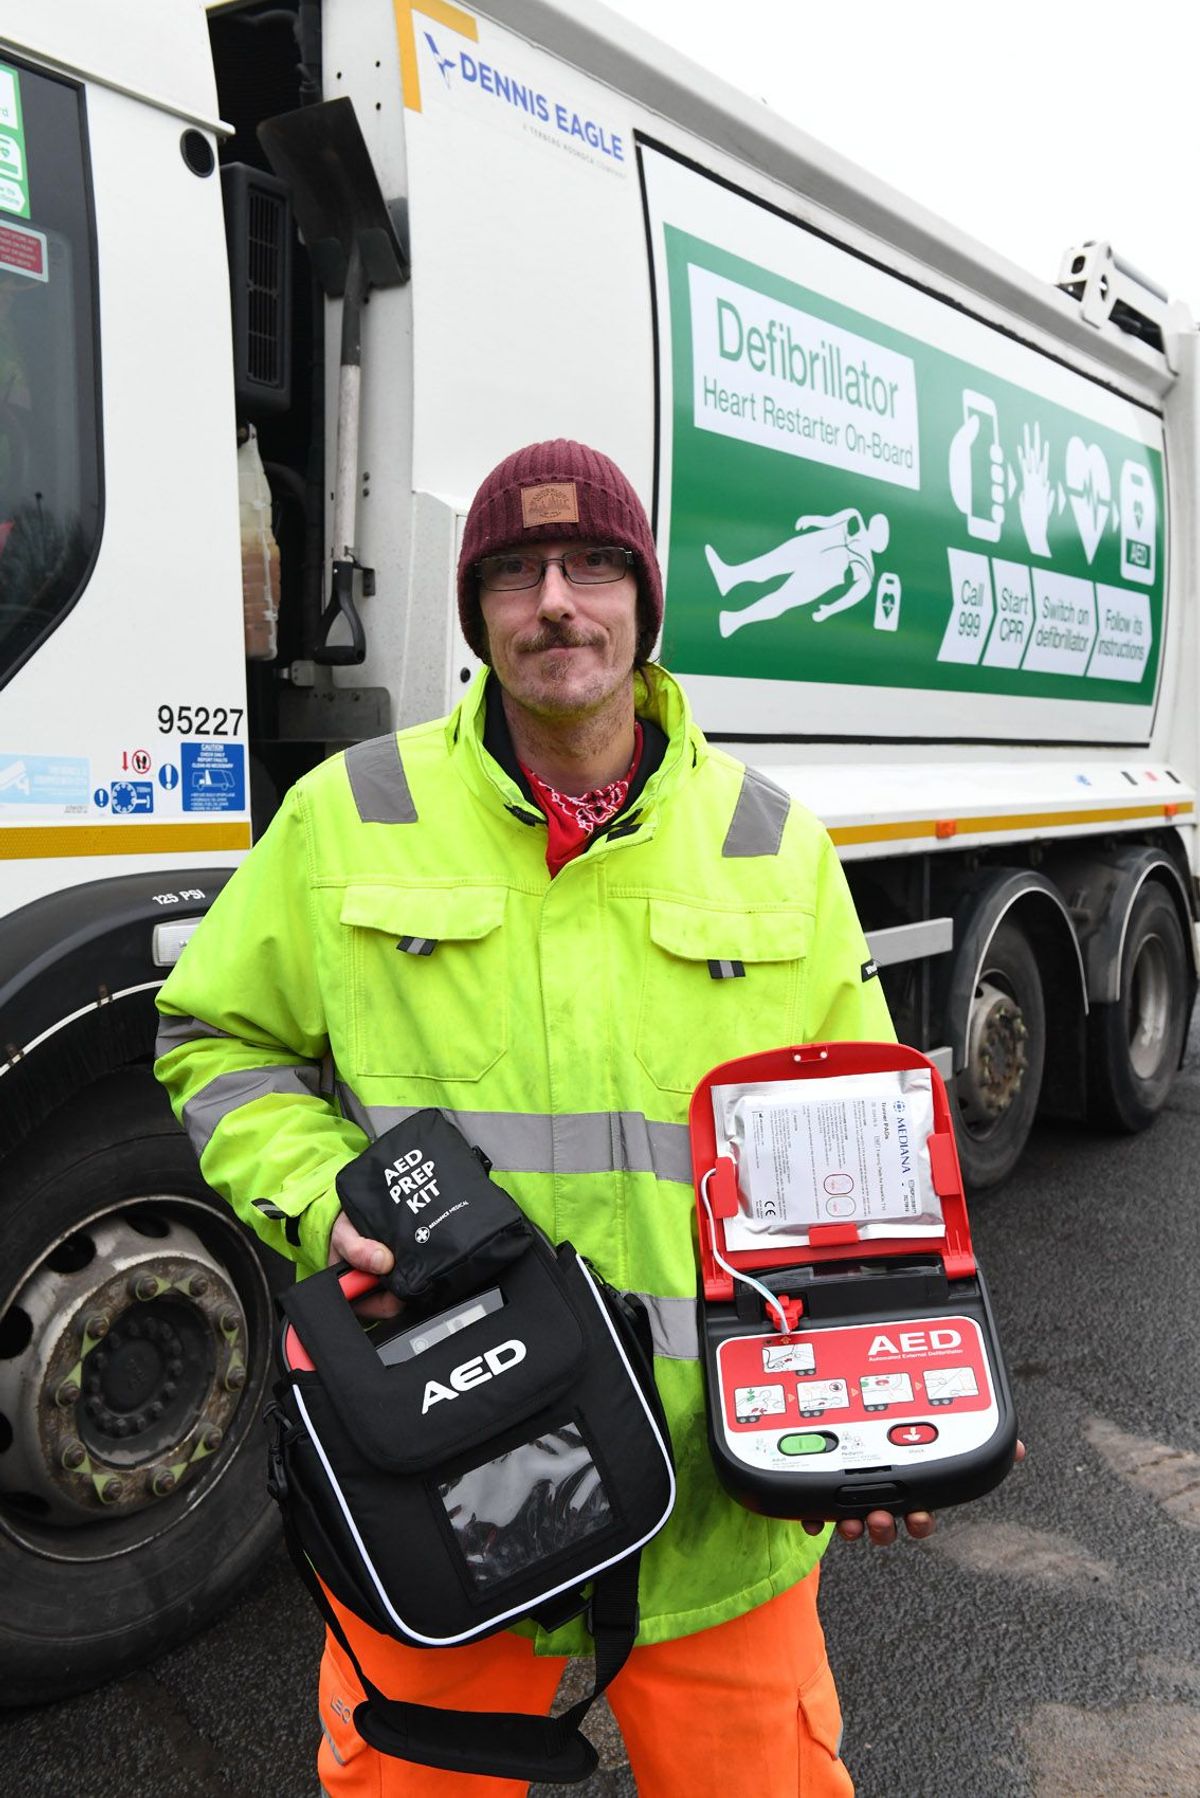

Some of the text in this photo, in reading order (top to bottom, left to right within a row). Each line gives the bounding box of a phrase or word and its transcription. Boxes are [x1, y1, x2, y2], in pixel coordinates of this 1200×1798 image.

[460, 52, 624, 161] DENNIS EAGLE
[717, 297, 899, 419] Defibrillator
[704, 376, 913, 469] Heart Restarter On-Board
[960, 579, 985, 607] Call
[1001, 588, 1029, 615] Start
[958, 611, 981, 638] 999
[1042, 596, 1089, 626] Switch on
[1104, 609, 1143, 636] Follow its
[1000, 618, 1024, 643] CPR
[1035, 625, 1089, 652] defibrillator
[1098, 637, 1145, 661] instructions
[158, 704, 243, 736] 95227
[152, 889, 206, 905] 125 PSI
[897, 1117, 911, 1173] MEDIANA
[384, 1149, 423, 1187] AED
[389, 1160, 435, 1204] PREP
[406, 1179, 440, 1214] KIT
[429, 1200, 469, 1229] RELIANCE MEDICAL
[868, 1329, 962, 1356] AED
[901, 1351, 927, 1359] External
[421, 1339, 527, 1415] AED
